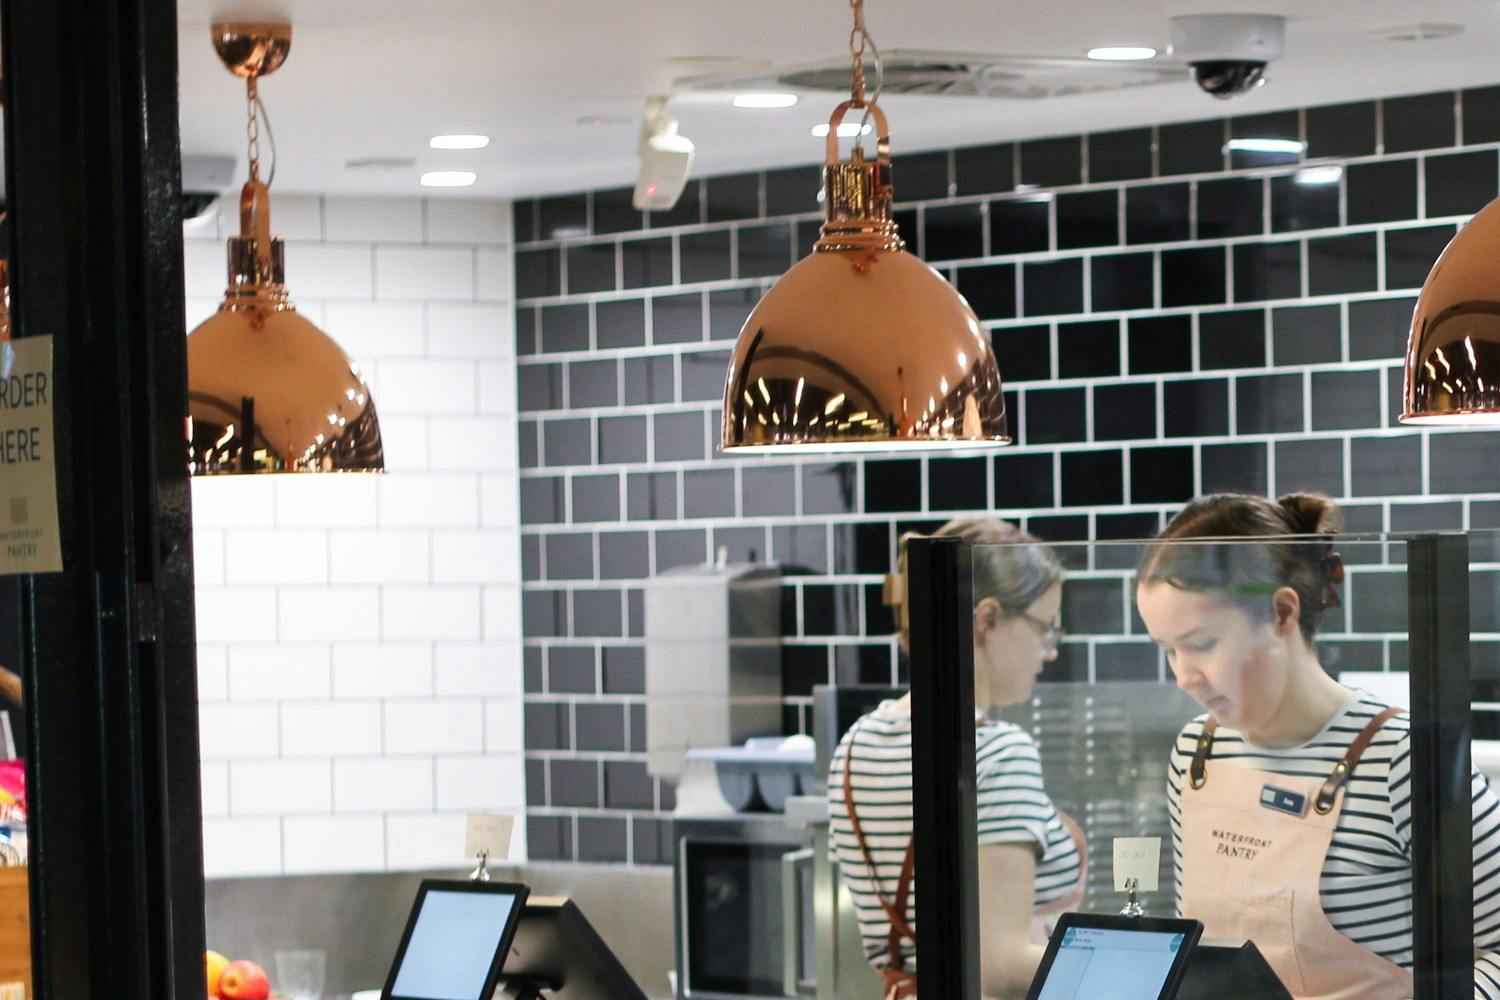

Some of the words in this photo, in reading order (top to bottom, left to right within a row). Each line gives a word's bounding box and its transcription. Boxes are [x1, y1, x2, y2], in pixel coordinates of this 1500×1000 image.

[0, 371, 47, 409] RDER
[1211, 829, 1273, 848] WATERFRONT
[1216, 842, 1259, 861] PANTRY
